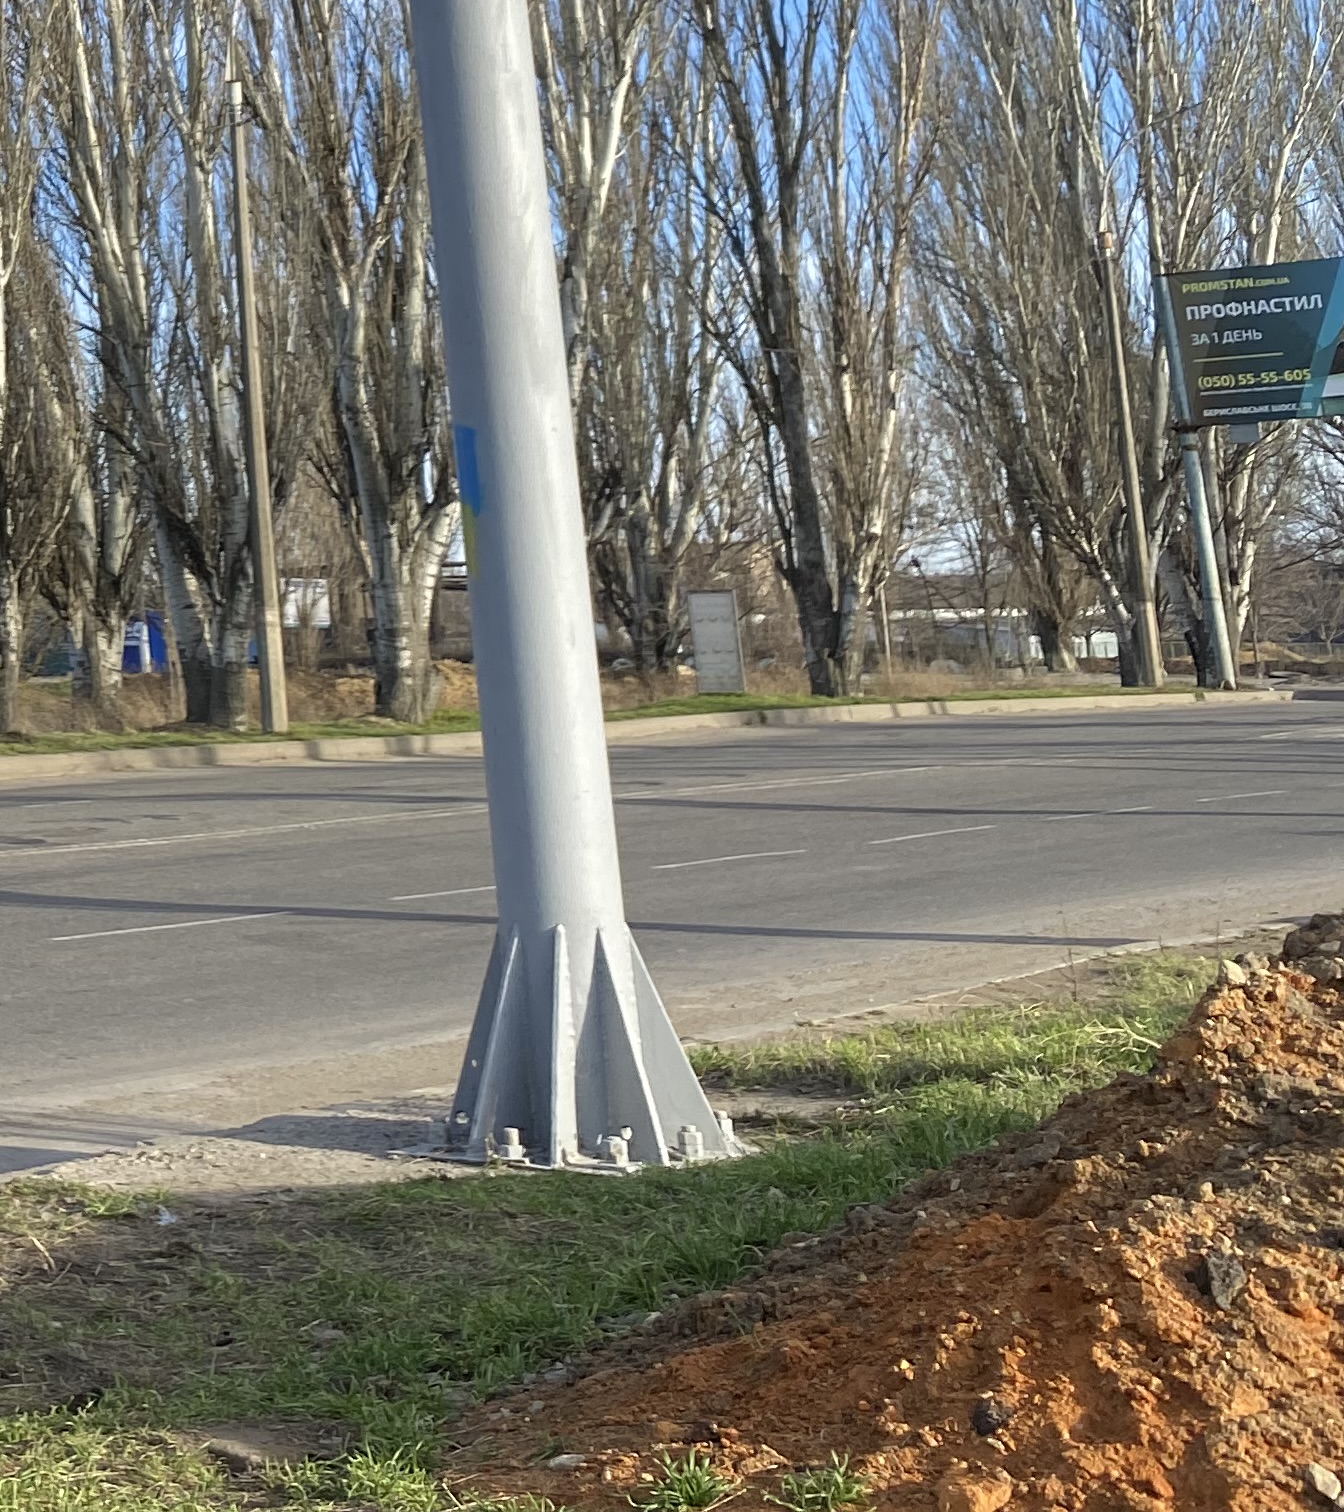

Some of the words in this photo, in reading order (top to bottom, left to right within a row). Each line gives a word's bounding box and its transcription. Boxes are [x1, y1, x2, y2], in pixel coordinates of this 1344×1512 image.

[1186, 294, 1323, 321] ПРОФНАСТИЛ
[1191, 333, 1211, 346] ЗА
[1212, 332, 1220, 344] 1
[1222, 329, 1263, 345] ДЕНЬ
[1198, 373, 1235, 389] (050)
[1238, 368, 1312, 385] 55-55-605
